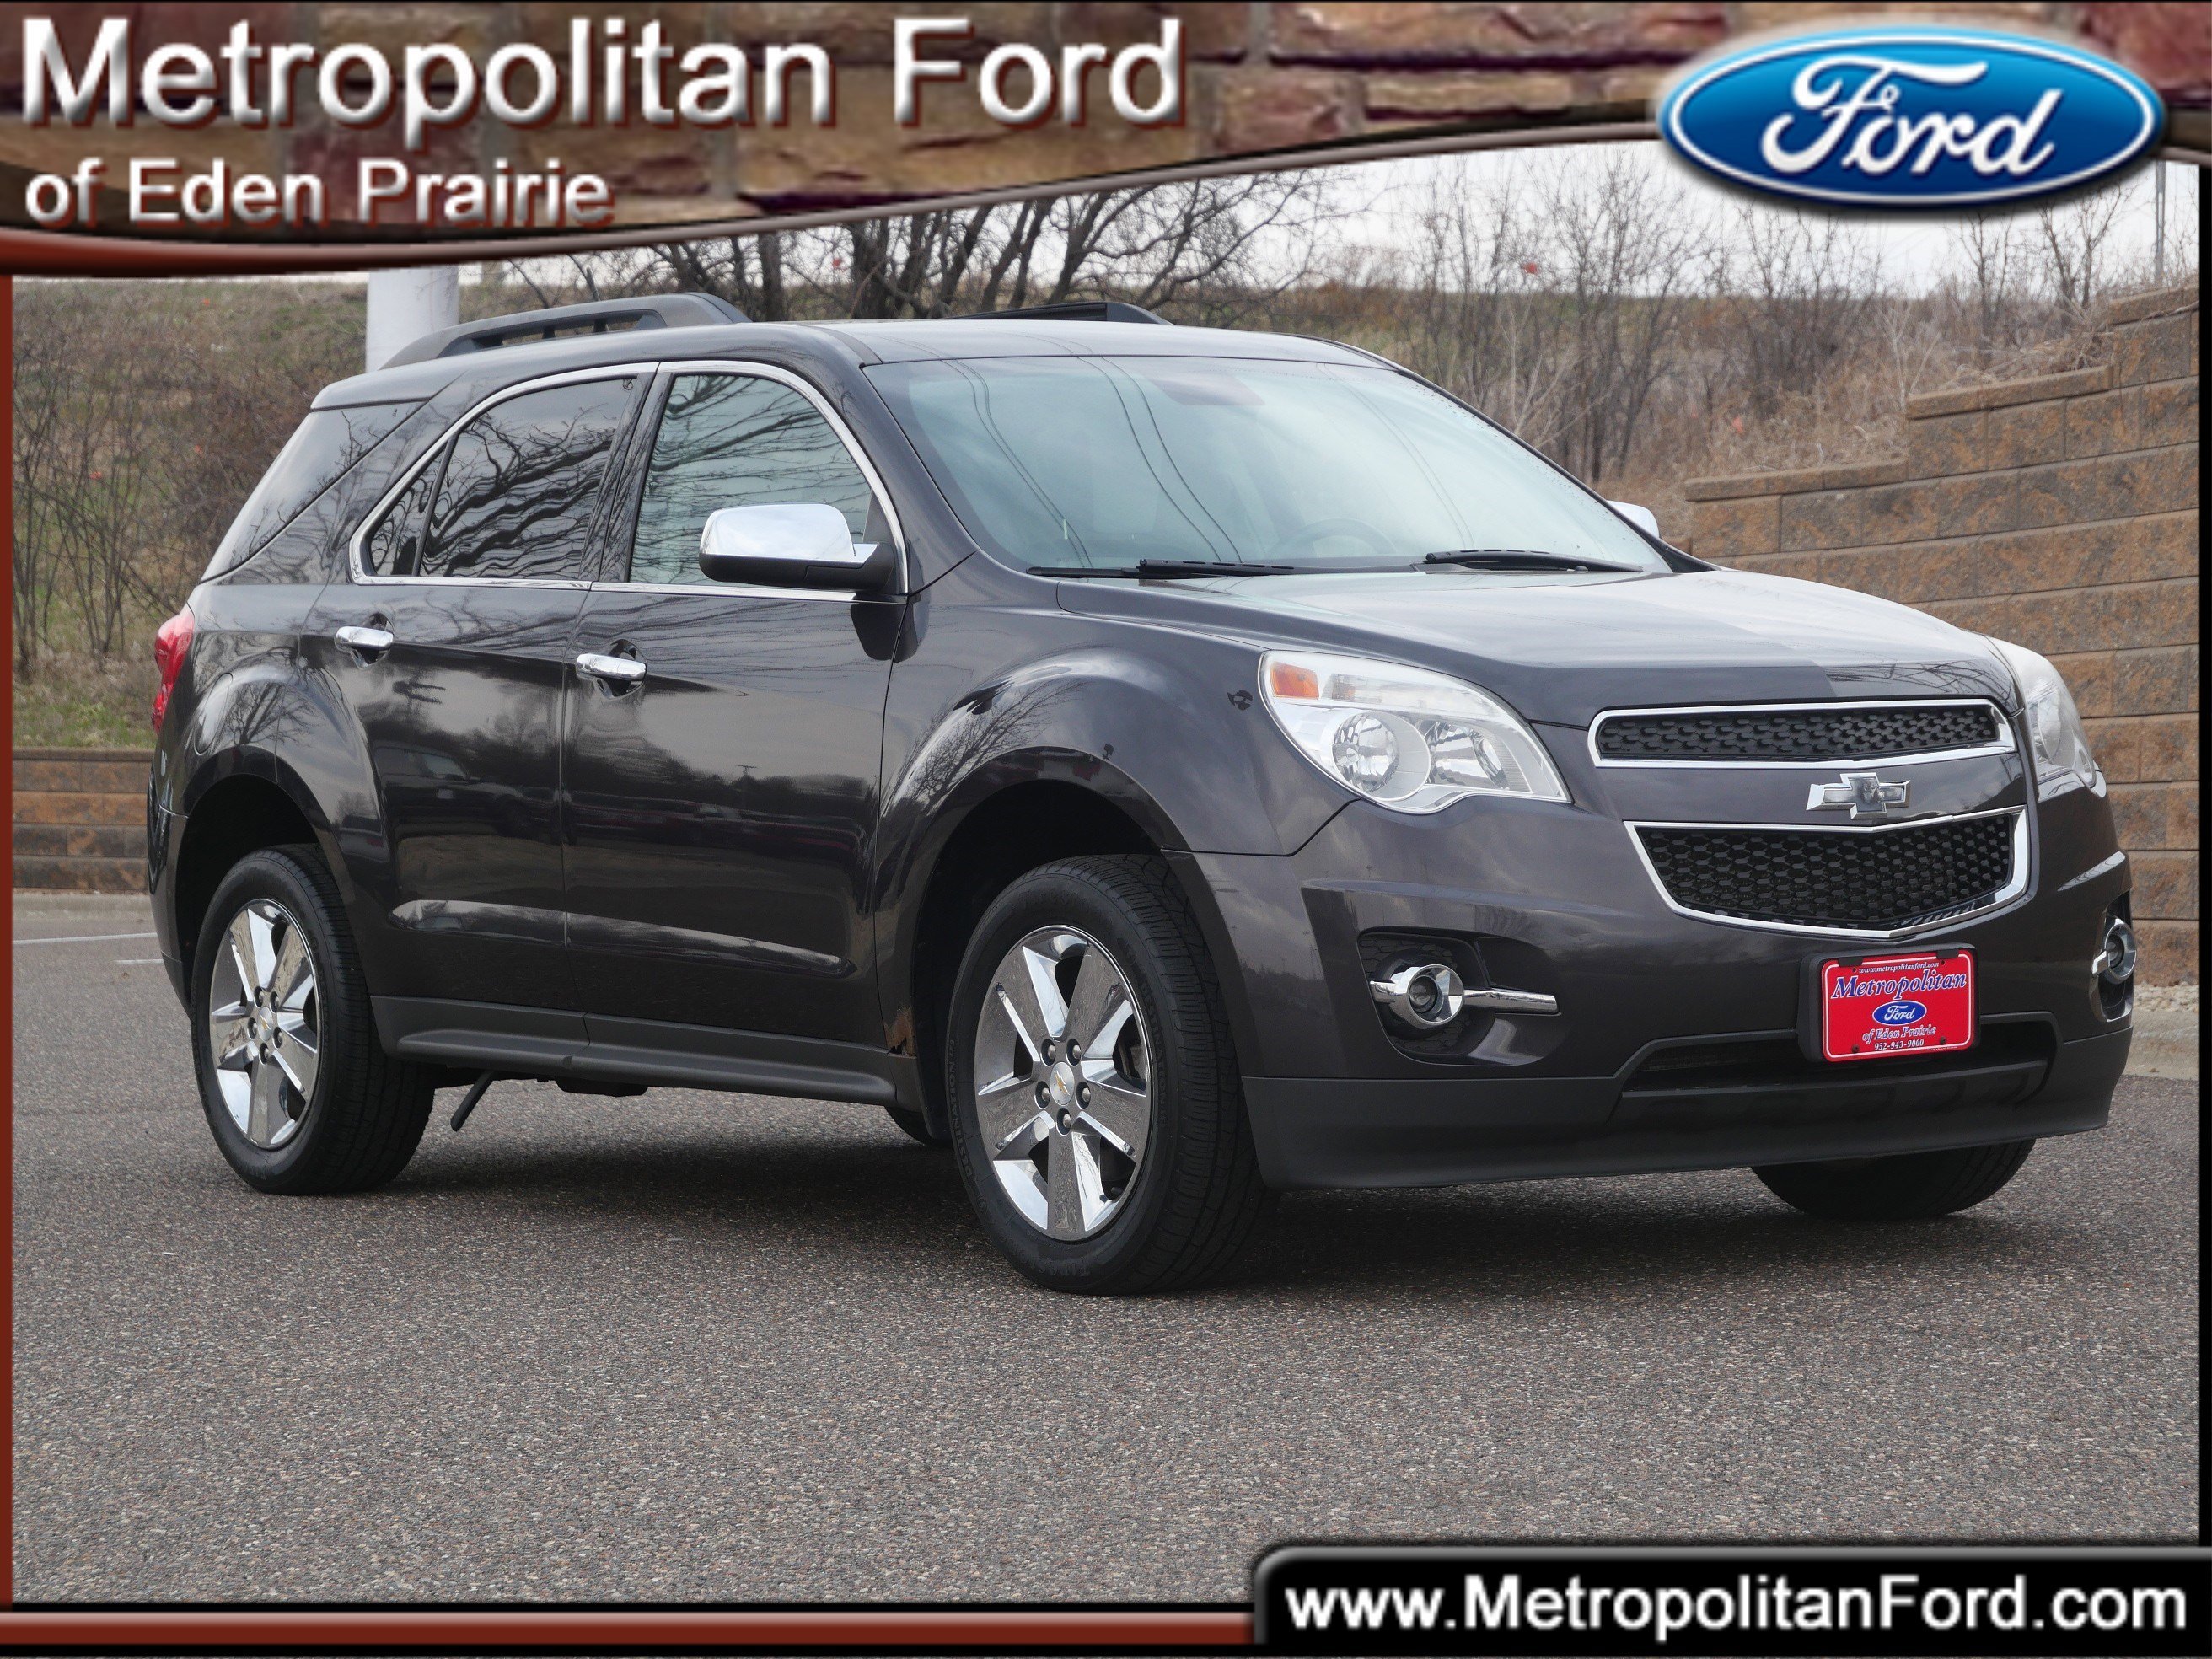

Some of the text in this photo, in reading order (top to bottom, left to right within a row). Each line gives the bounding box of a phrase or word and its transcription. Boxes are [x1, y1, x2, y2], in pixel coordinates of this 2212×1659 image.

[1859, 962, 1939, 974] www.metropolitanford.com
[1831, 969, 1967, 1000] Metropolitan
[1884, 1005, 1915, 1021] Ford
[1862, 1023, 1936, 1044] of Eden Prairie
[1874, 1039, 1925, 1051] 952-943-9000
[948, 1060, 974, 1178] DESTINATION
